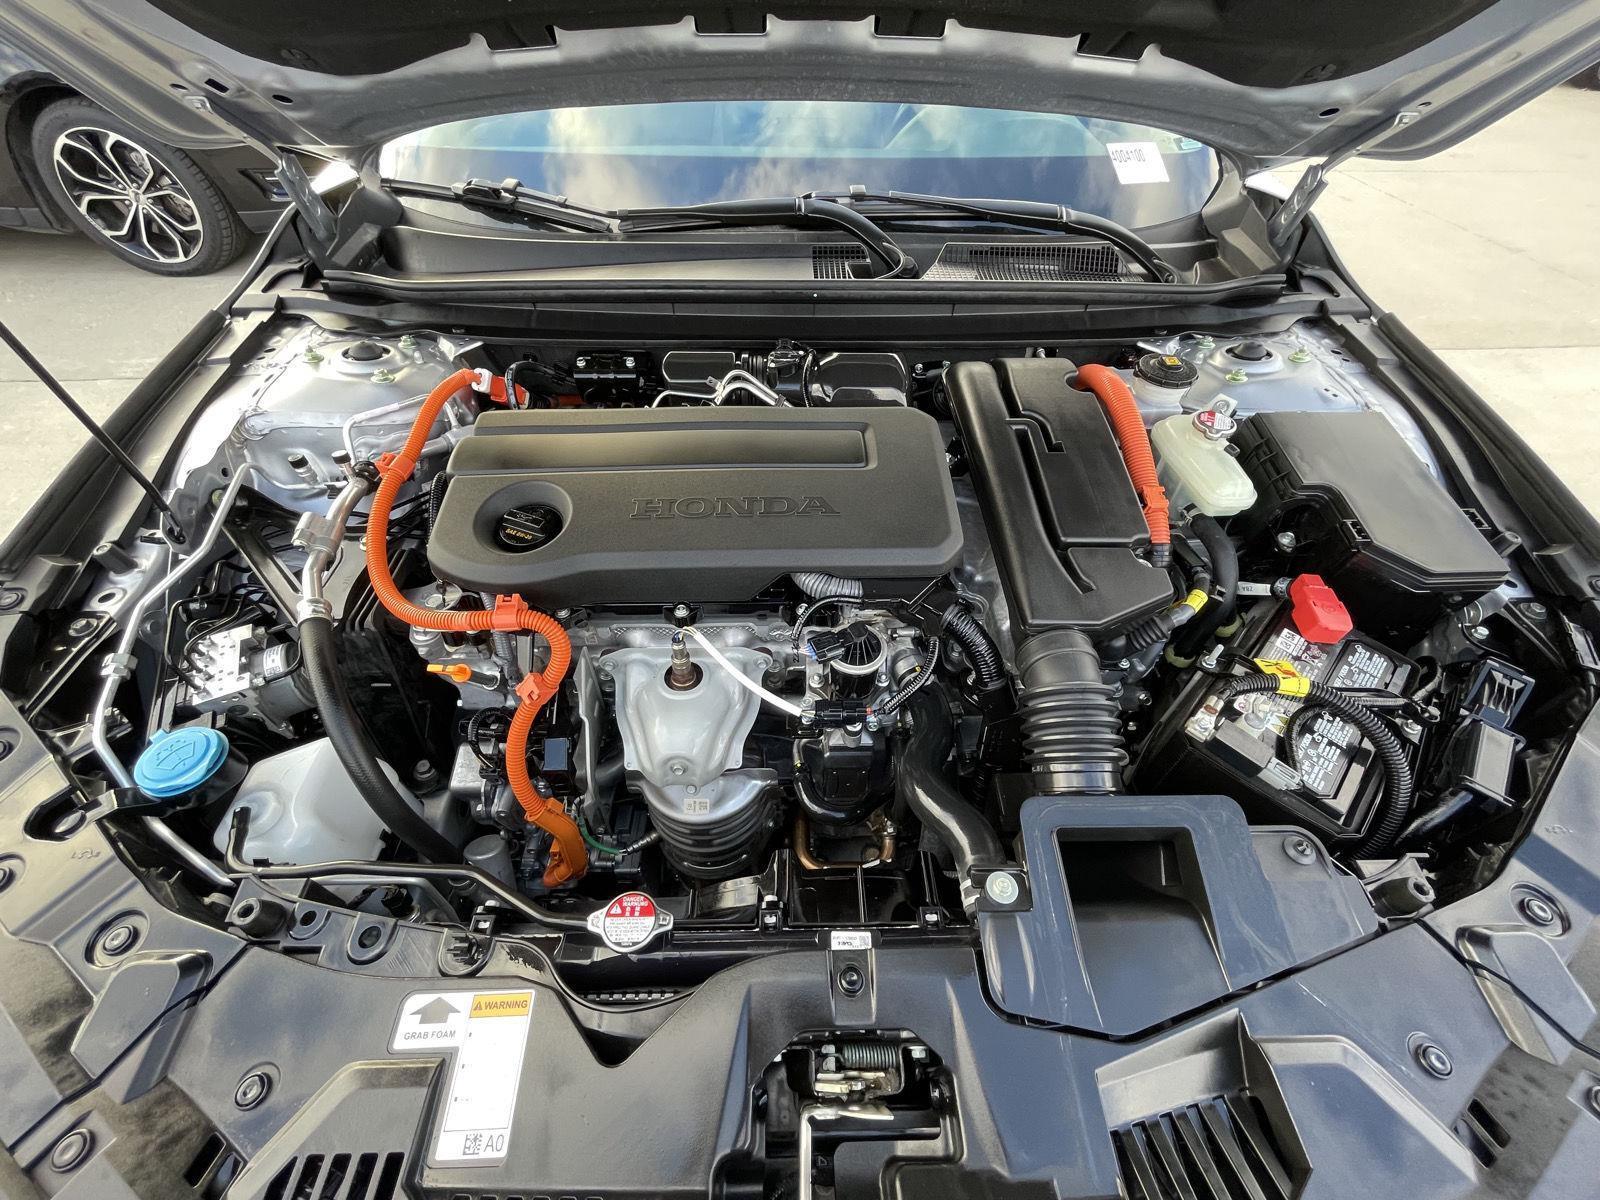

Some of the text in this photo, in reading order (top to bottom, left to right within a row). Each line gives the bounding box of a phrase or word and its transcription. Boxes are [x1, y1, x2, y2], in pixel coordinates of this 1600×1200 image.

[629, 496, 841, 519] HONDA
[484, 999, 528, 1010] WARNING
[403, 1030, 456, 1040] GRAB FOAM
